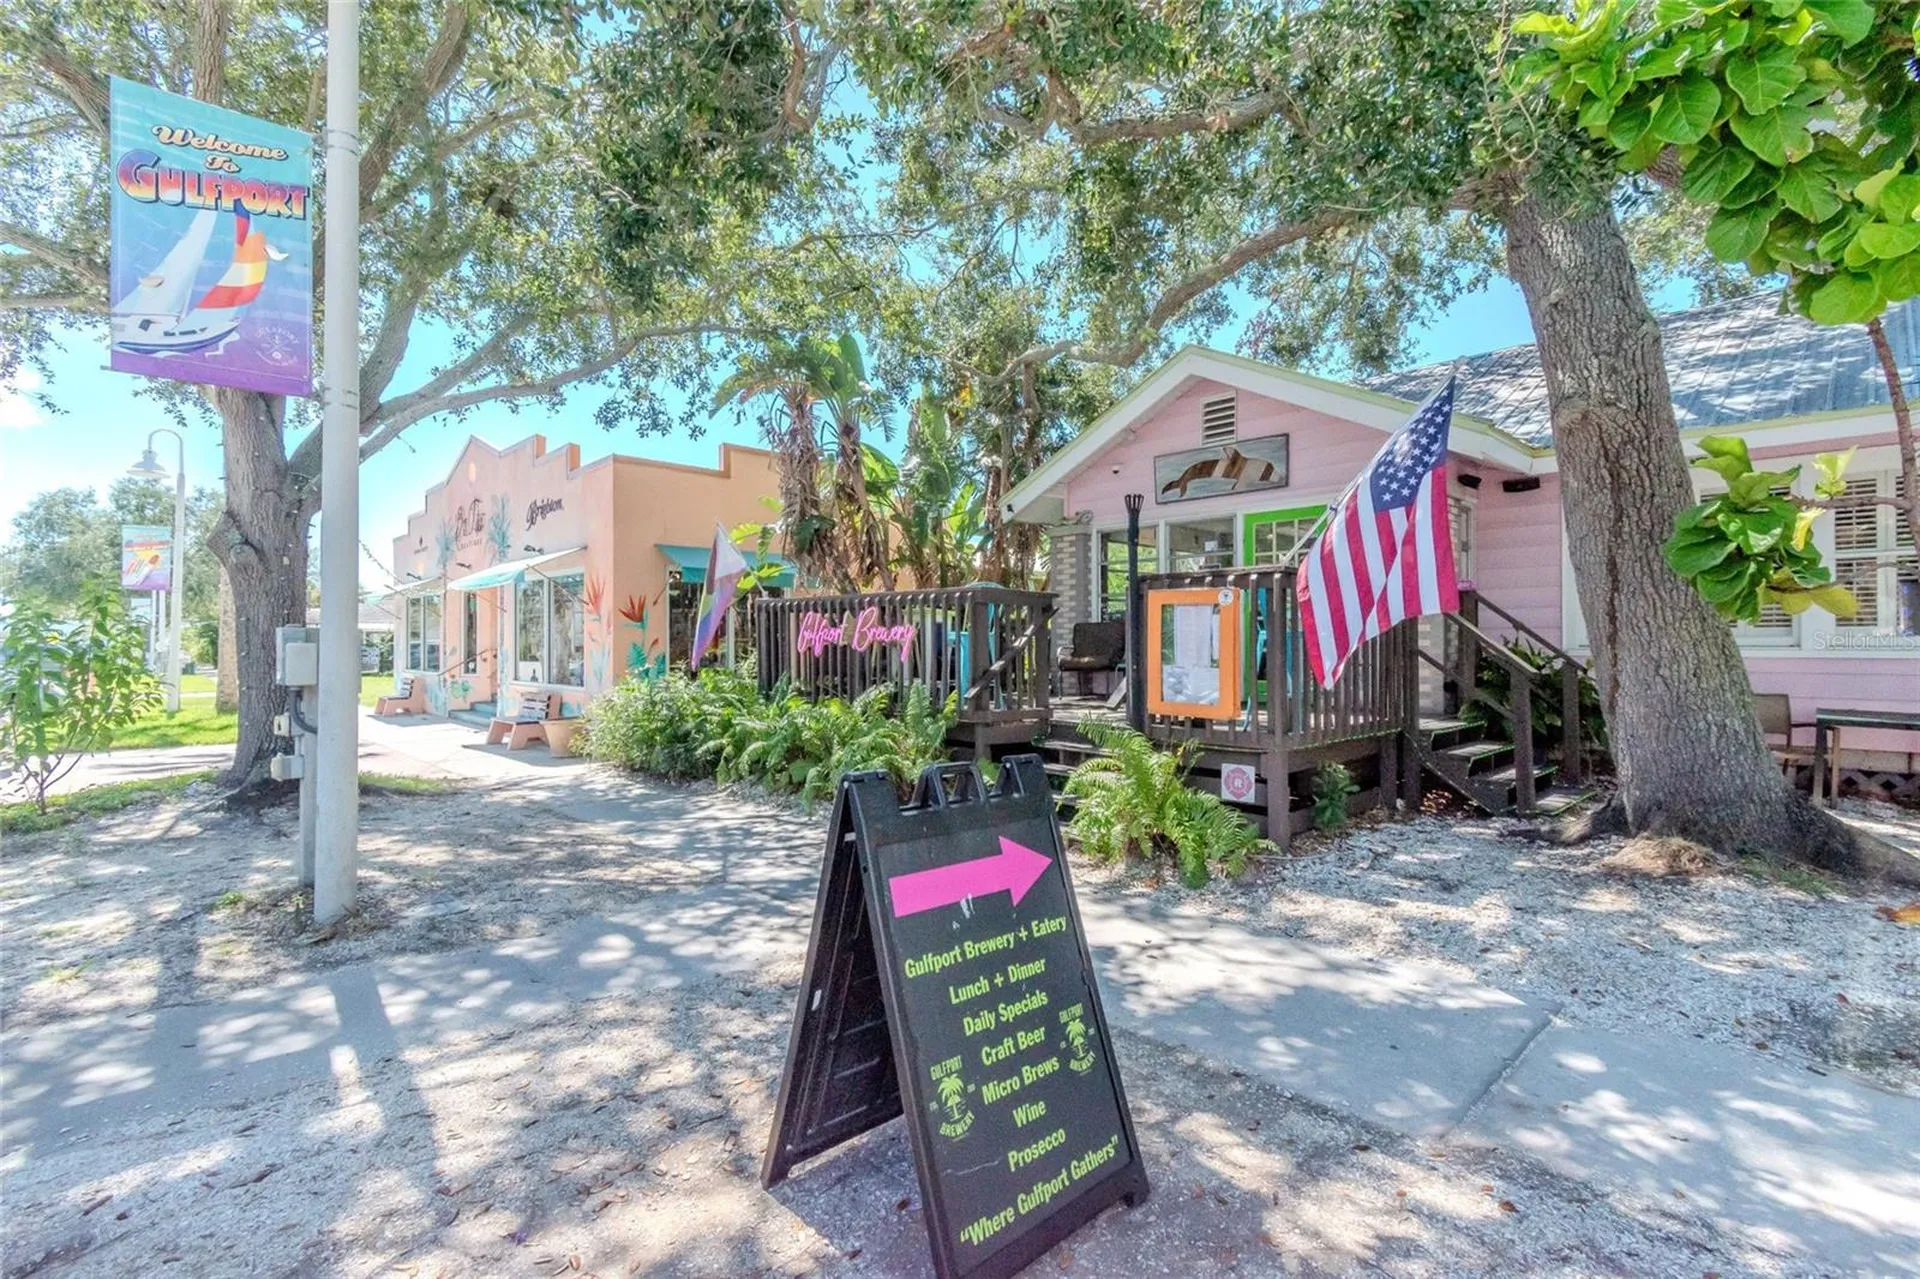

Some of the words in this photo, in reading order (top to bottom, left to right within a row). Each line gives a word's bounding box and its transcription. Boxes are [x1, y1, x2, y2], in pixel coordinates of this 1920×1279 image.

[152, 125, 288, 160] Welcome
[205, 154, 242, 173] To
[116, 148, 311, 220] GULFPORT
[851, 606, 918, 662] Brewery
[904, 946, 962, 978] Gulfport
[964, 932, 1015, 960] Brewery
[1018, 924, 1029, 941] +
[1031, 916, 1067, 938] Eatery
[949, 976, 990, 1004] Lunch
[994, 972, 1004, 988] +
[1007, 957, 1046, 983] Dinner
[963, 1010, 996, 1036] Daily
[998, 989, 1048, 1022] Specials
[981, 1037, 1016, 1066] Craft
[1017, 1026, 1046, 1050] Beer
[982, 1076, 1020, 1105] Micro
[1022, 1056, 1060, 1085] Brews
[1012, 1101, 1047, 1128] Wine
[1008, 1128, 1066, 1172] Prosecco
[1017, 1168, 1070, 1215] Gulfport
